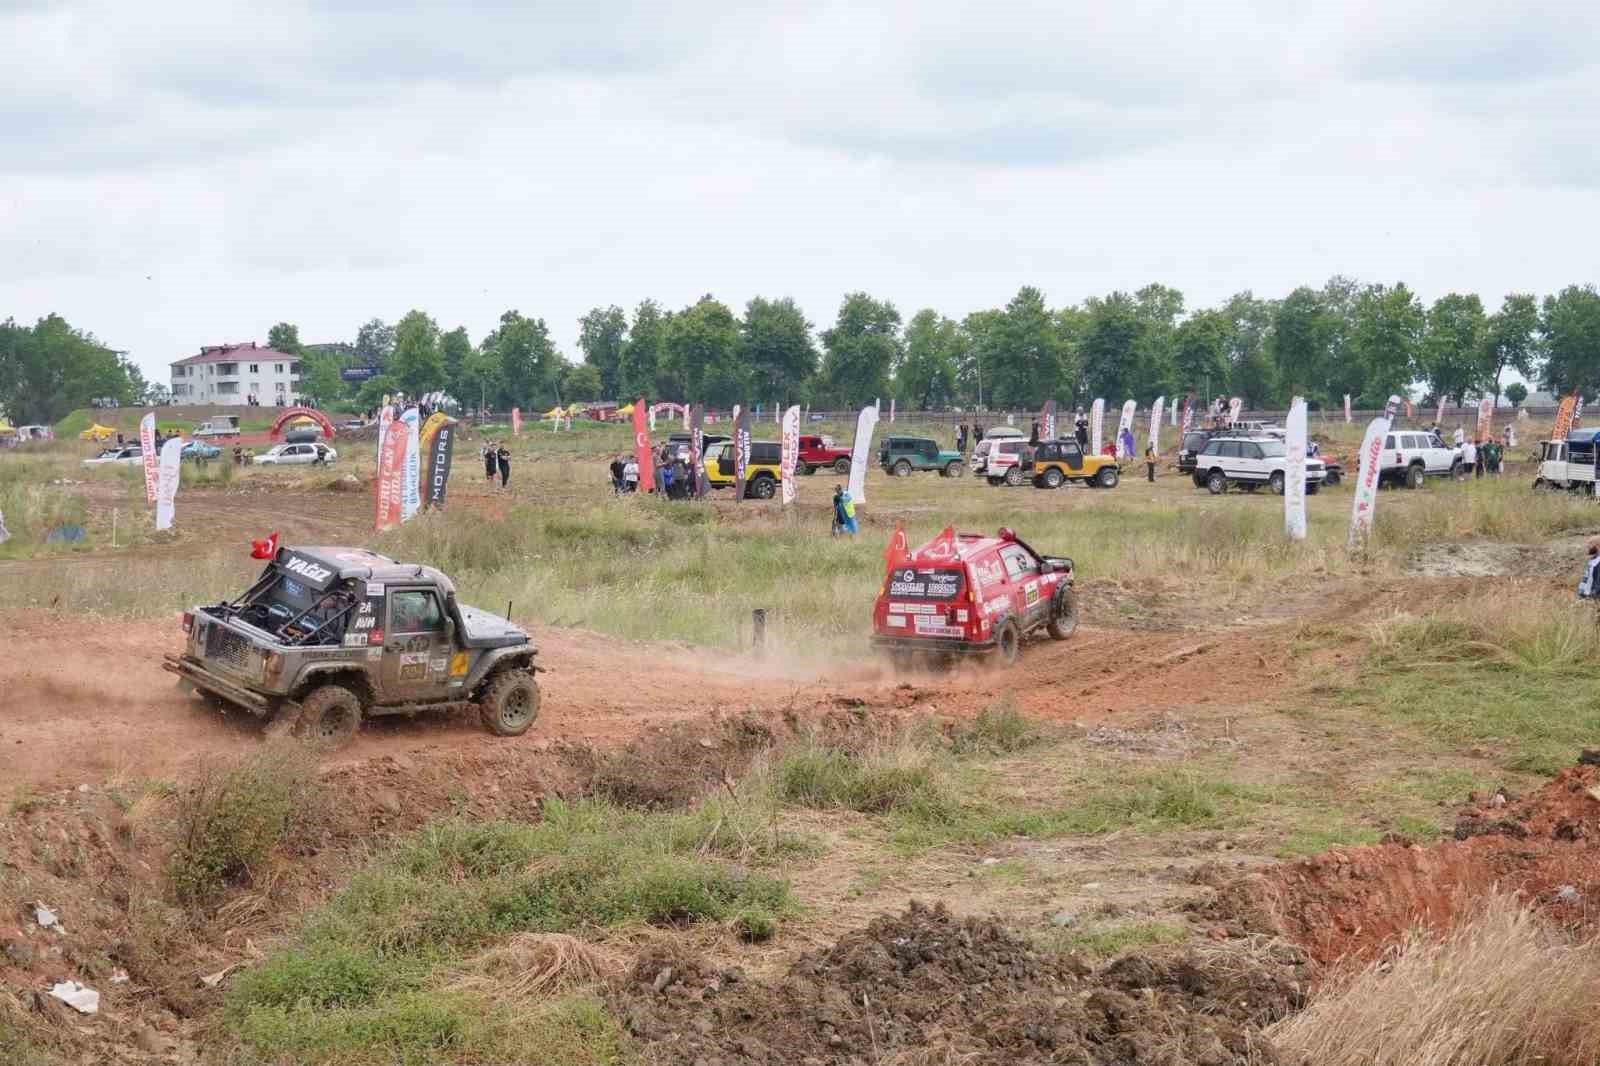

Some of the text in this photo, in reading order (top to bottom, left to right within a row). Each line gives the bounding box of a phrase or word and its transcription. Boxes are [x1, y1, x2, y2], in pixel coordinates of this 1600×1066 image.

[383, 448, 393, 477] CAN
[432, 430, 449, 500] MOTORS
[354, 616, 376, 629] AVM
